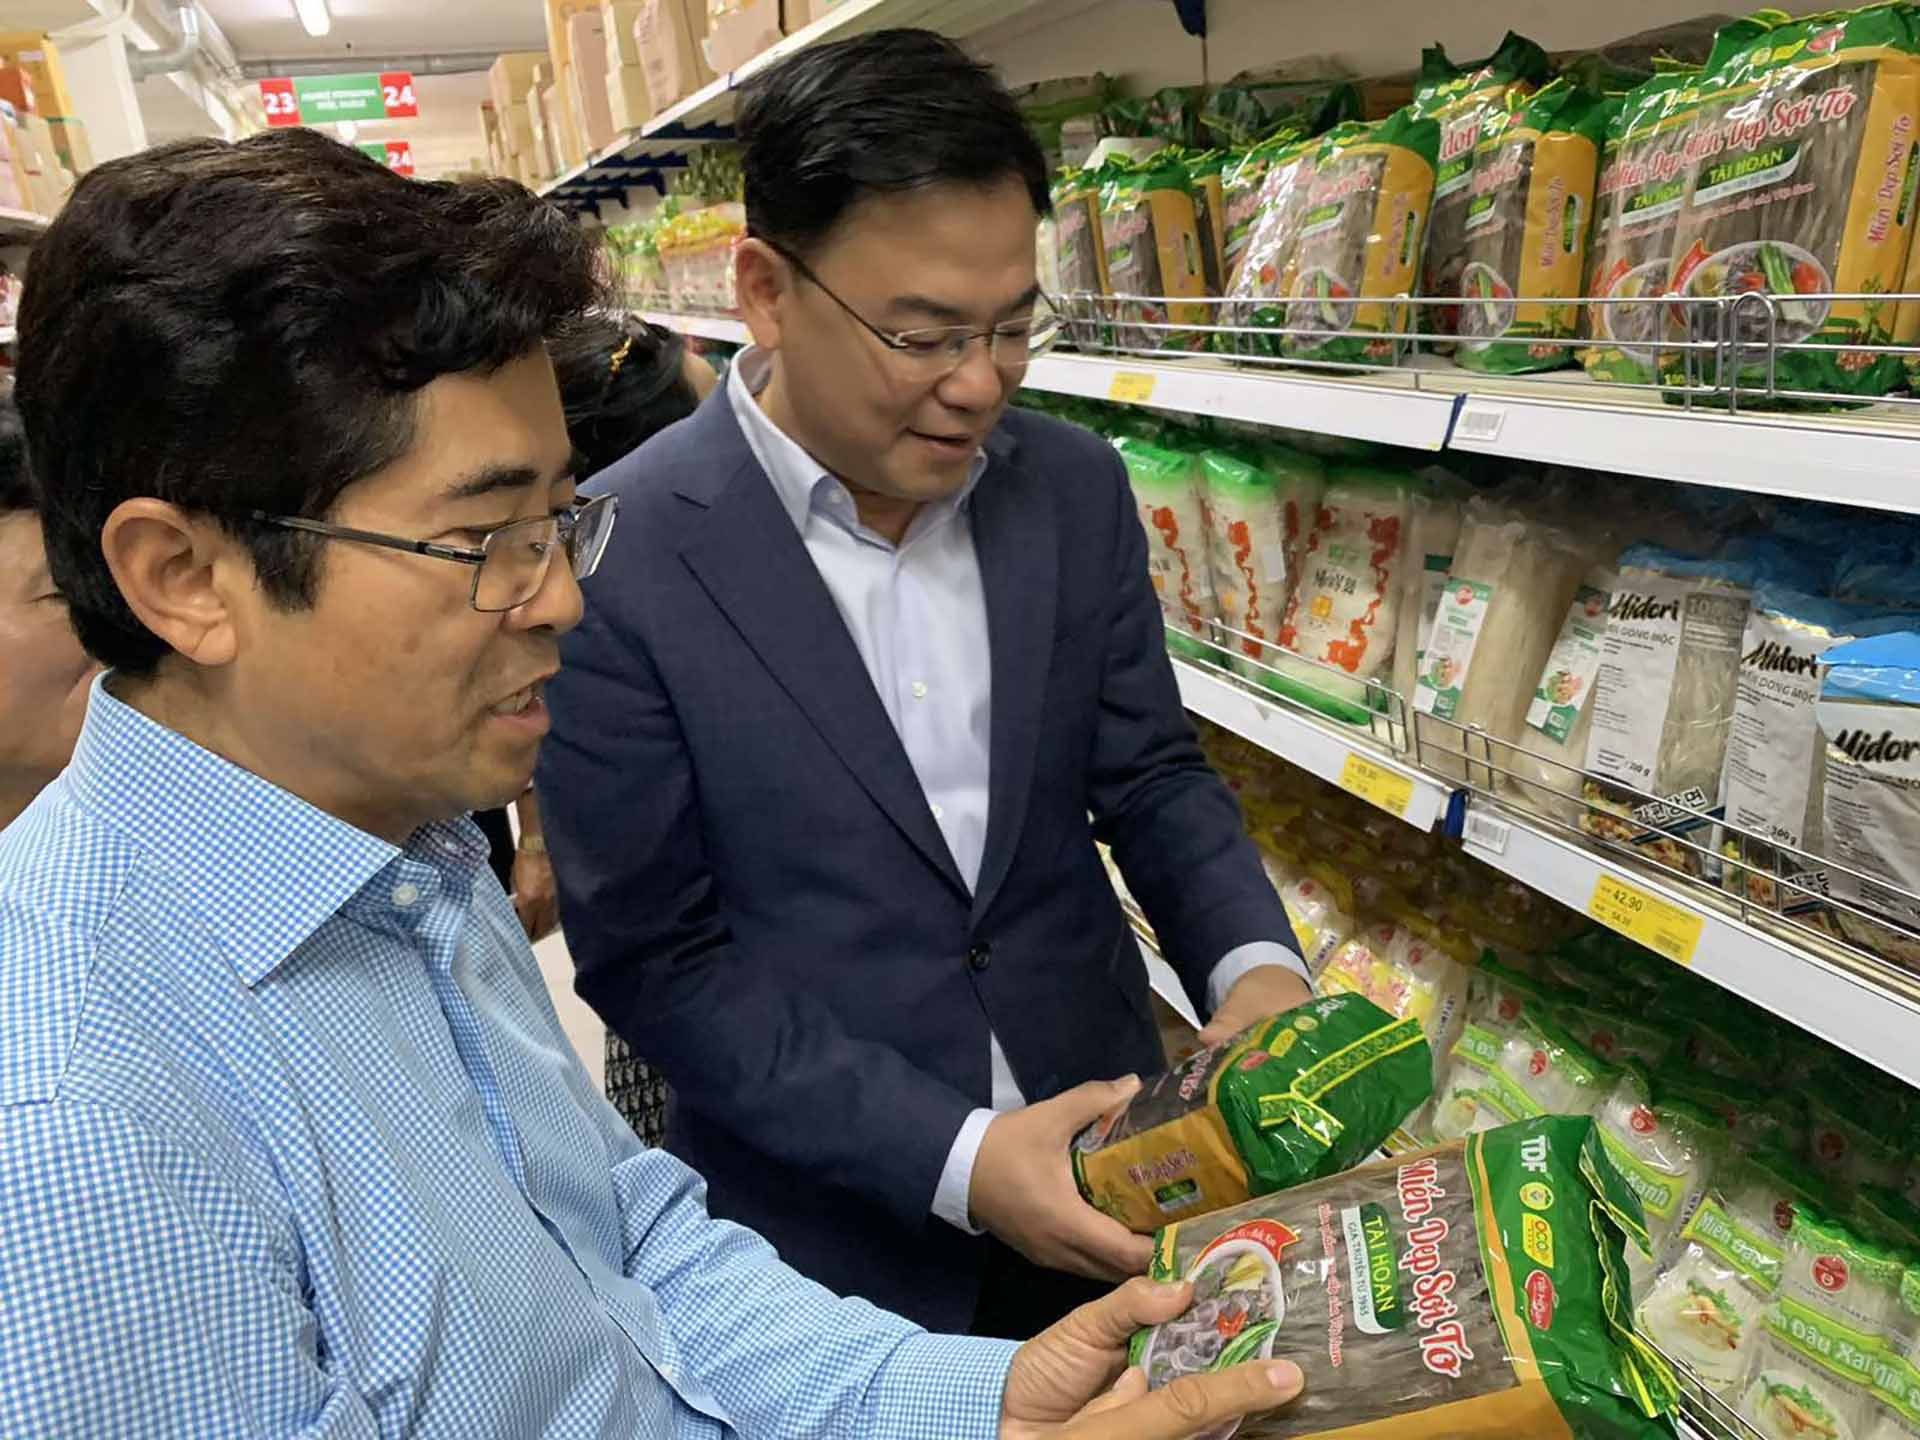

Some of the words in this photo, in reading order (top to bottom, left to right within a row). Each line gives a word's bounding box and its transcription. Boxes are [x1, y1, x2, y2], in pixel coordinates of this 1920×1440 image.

[263, 92, 296, 114] 23
[383, 86, 417, 107] 24
[388, 150, 412, 167] 24
[1608, 593, 1681, 621] Midori
[1741, 640, 1818, 678] Midori
[1834, 729, 1920, 763] Midor
[1521, 1135, 1547, 1173] TDF
[1364, 1215, 1390, 1250] TÀI
[1369, 1252, 1396, 1313] HOAN
[1834, 1341, 1873, 1371] Xa
